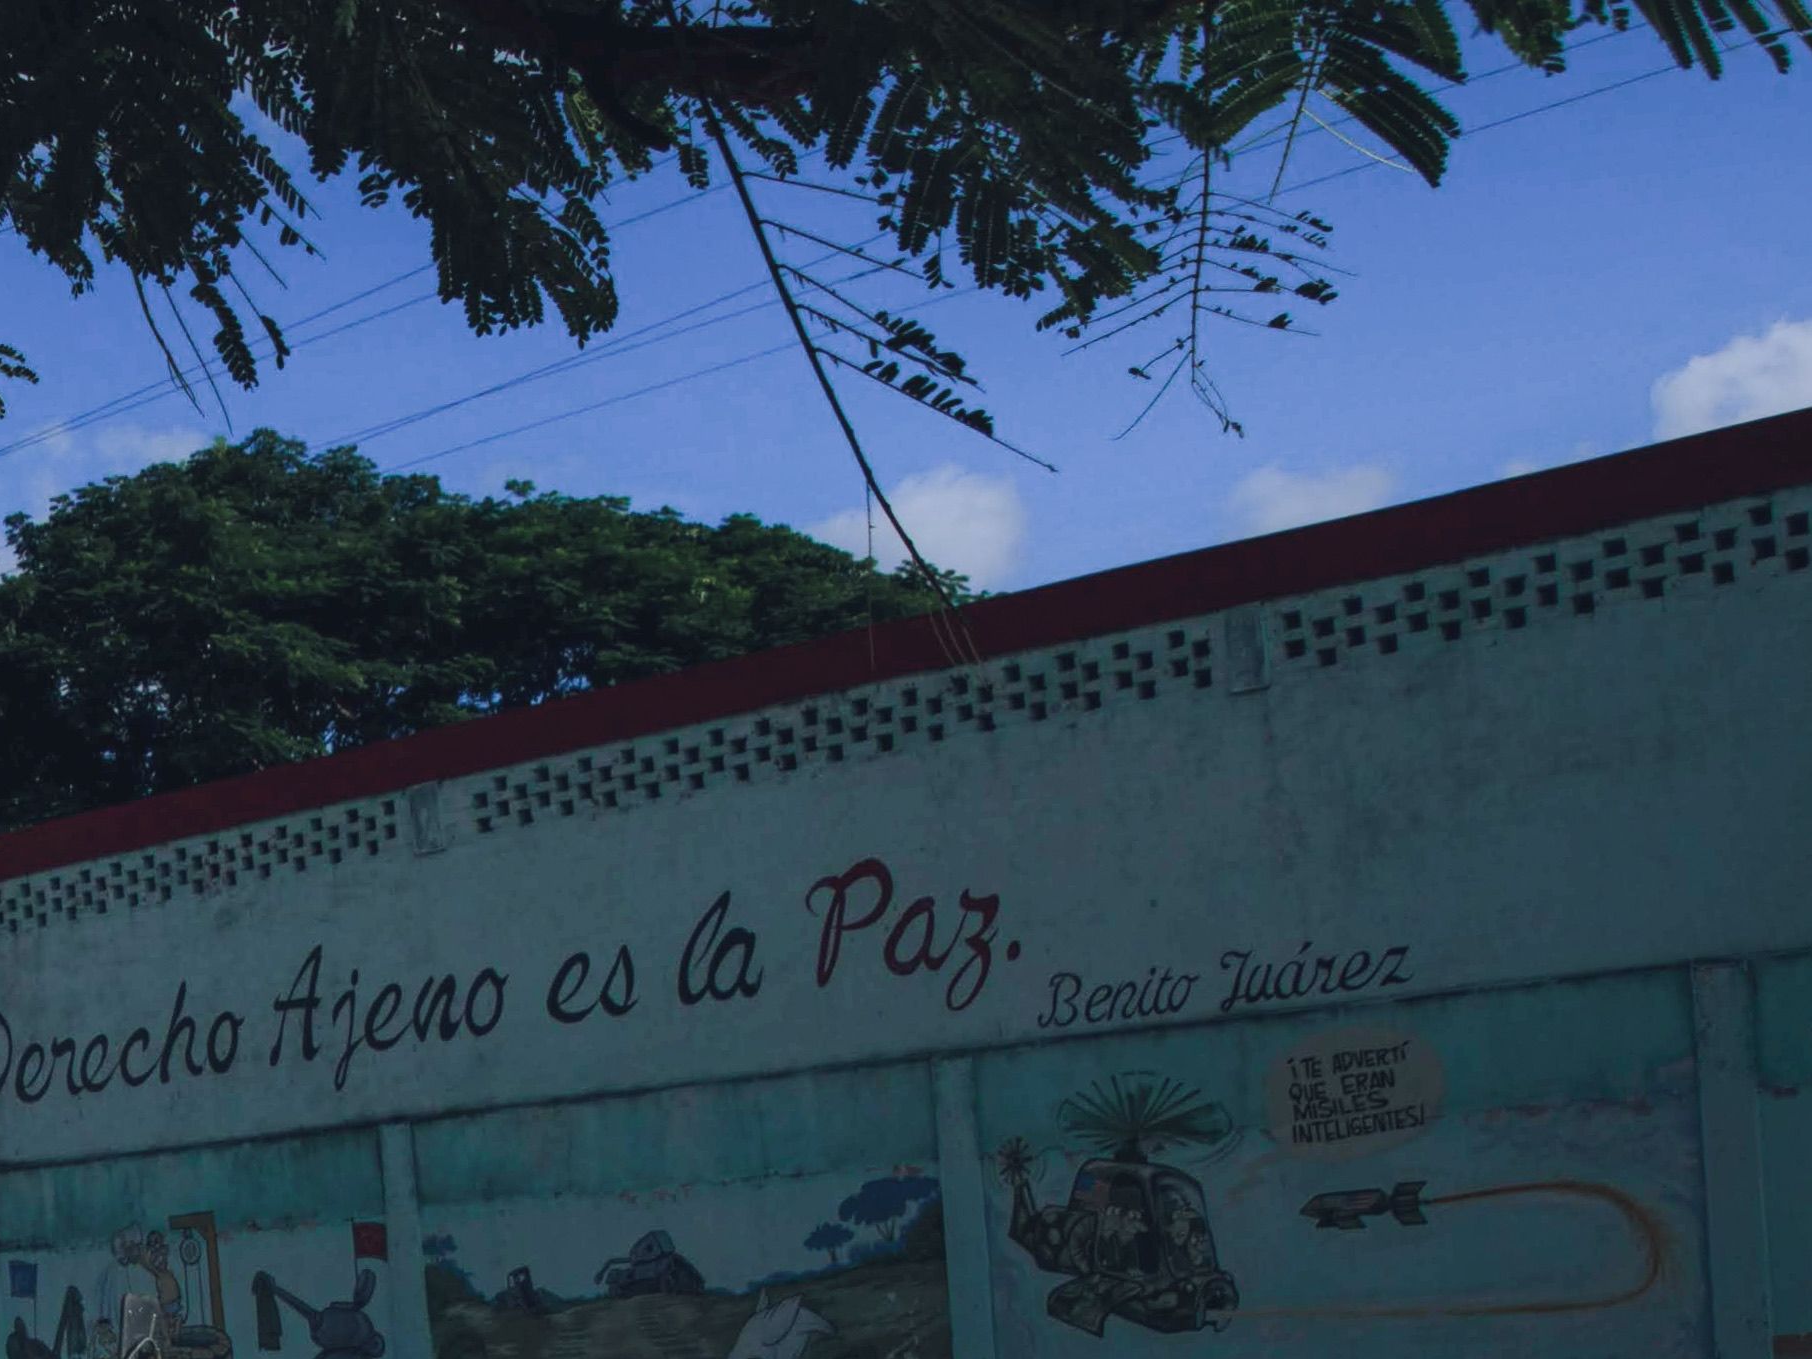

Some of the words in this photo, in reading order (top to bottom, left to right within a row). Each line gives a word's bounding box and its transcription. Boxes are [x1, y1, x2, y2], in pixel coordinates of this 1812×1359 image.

[269, 943, 511, 1092] Ajeno
[546, 943, 641, 1025] es
[677, 889, 765, 1007] la
[804, 856, 1023, 1012] Paz.
[1036, 966, 1201, 1029] Benito
[1219, 940, 1415, 1013] Juárez
[1288, 1081, 1328, 1105] QUE
[1340, 1068, 1396, 1096] ERAN
[1293, 1091, 1389, 1122] MISILES
